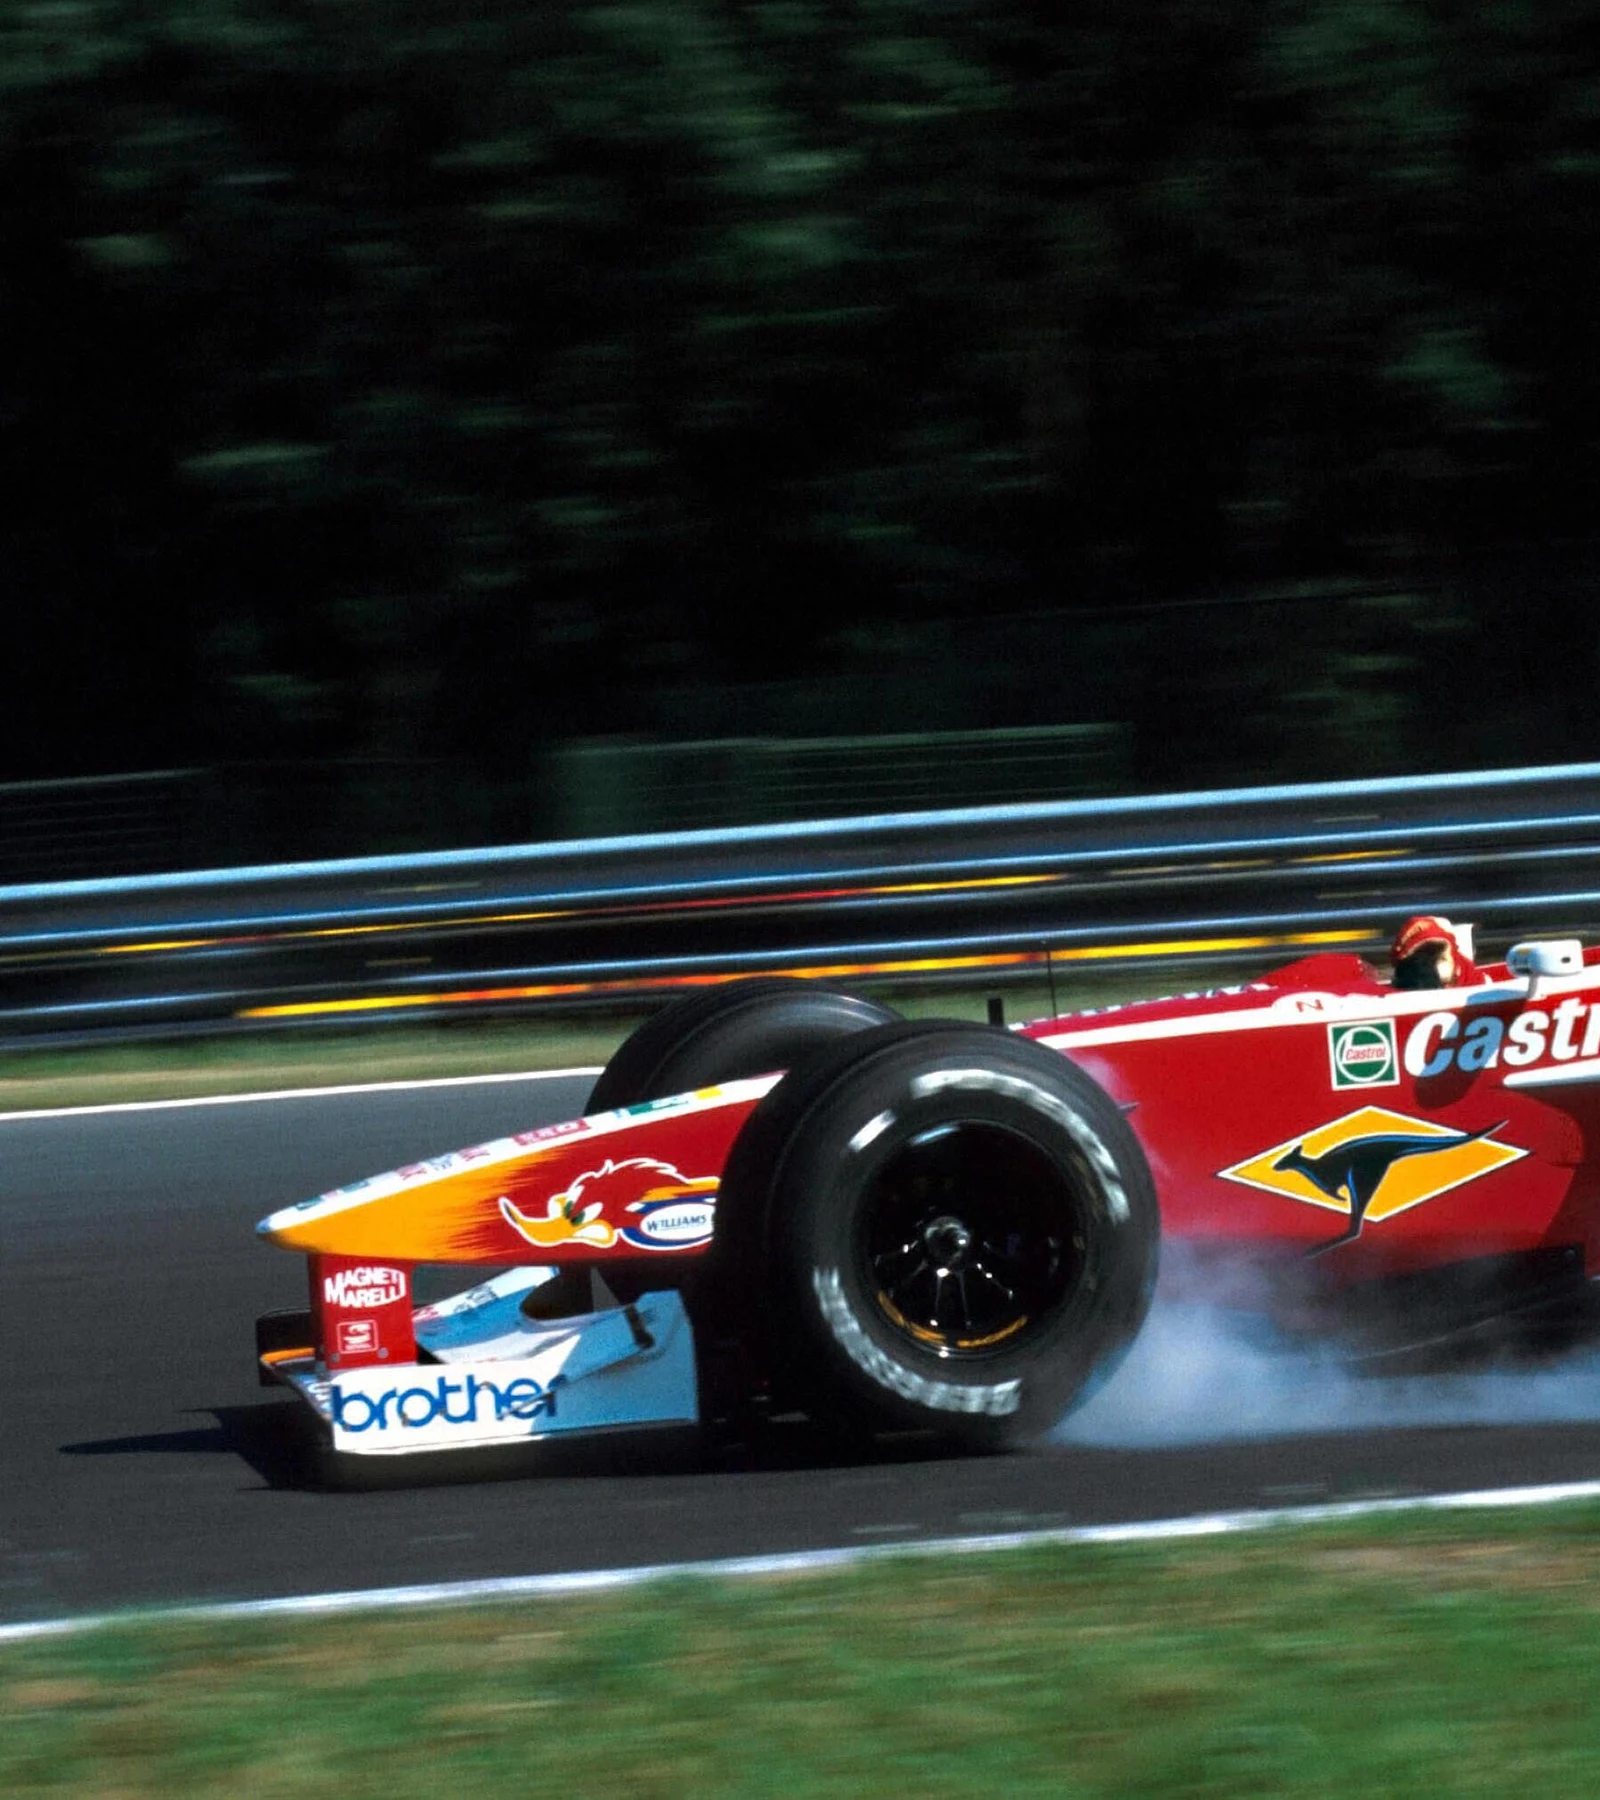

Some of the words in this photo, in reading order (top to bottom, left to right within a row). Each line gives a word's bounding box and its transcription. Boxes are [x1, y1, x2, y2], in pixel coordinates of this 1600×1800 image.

[1345, 1044, 1387, 1061] Castrol
[646, 1214, 707, 1233] WILLIAMS
[330, 1374, 563, 1433] brother
